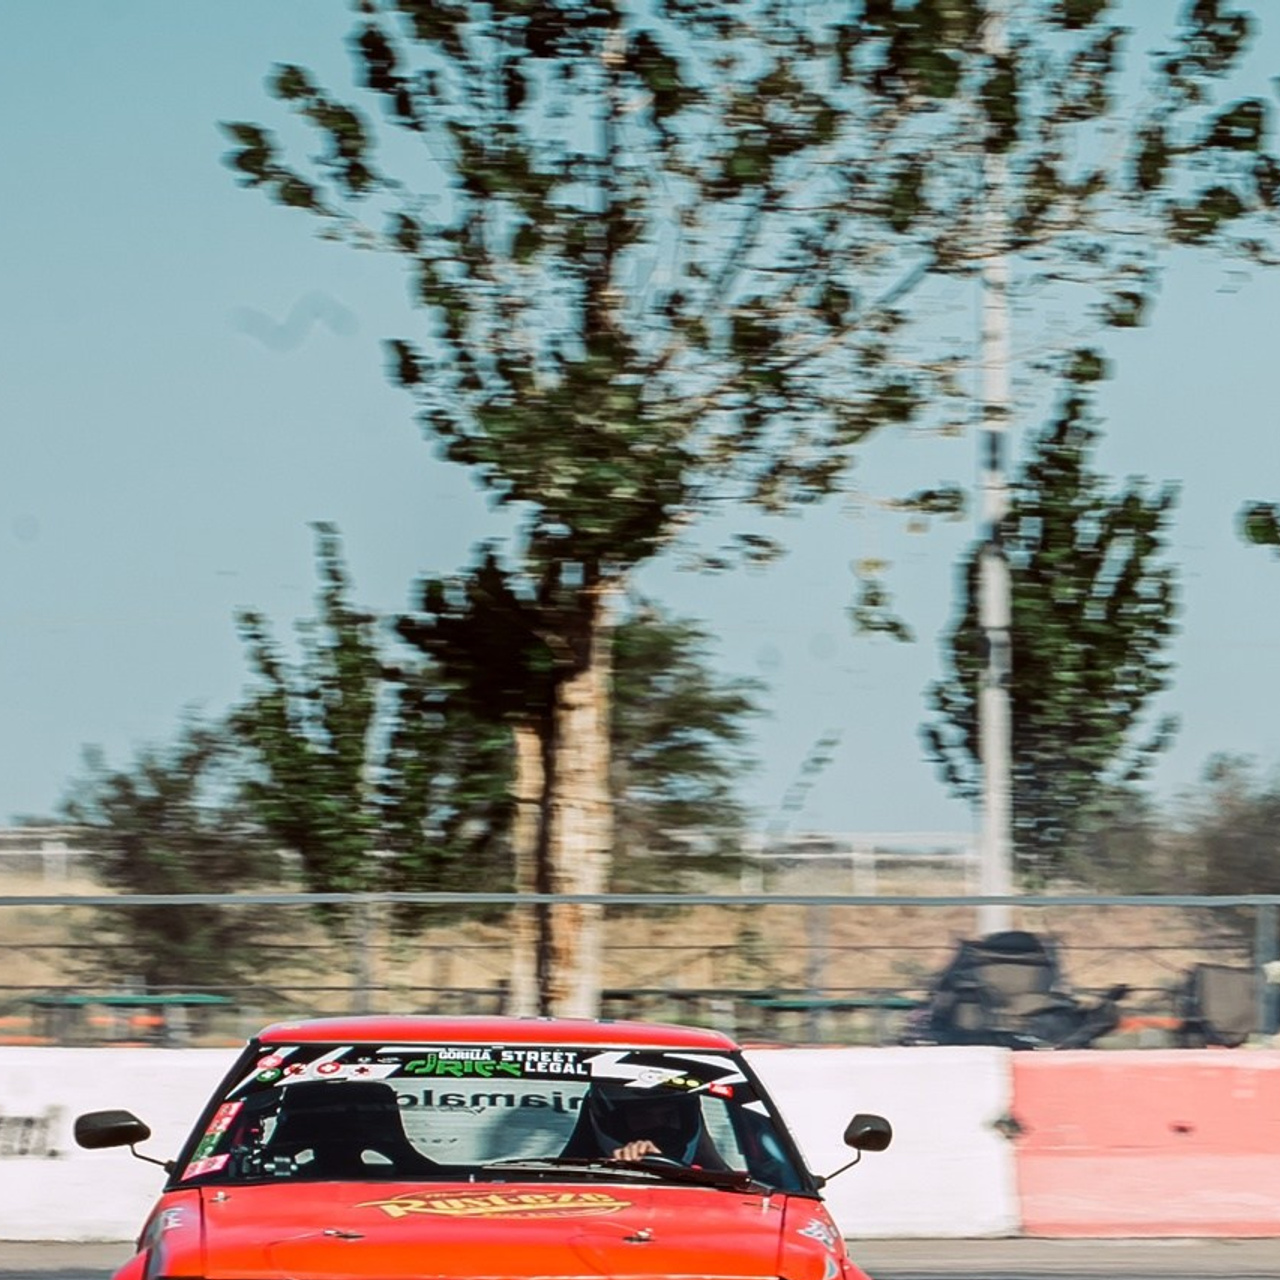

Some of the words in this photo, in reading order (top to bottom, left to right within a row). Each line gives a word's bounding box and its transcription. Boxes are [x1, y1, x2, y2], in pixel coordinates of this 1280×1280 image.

[438, 1050, 491, 1061] GORILLA
[501, 1050, 577, 1063] STREET
[524, 1062, 588, 1075] LEGAL
